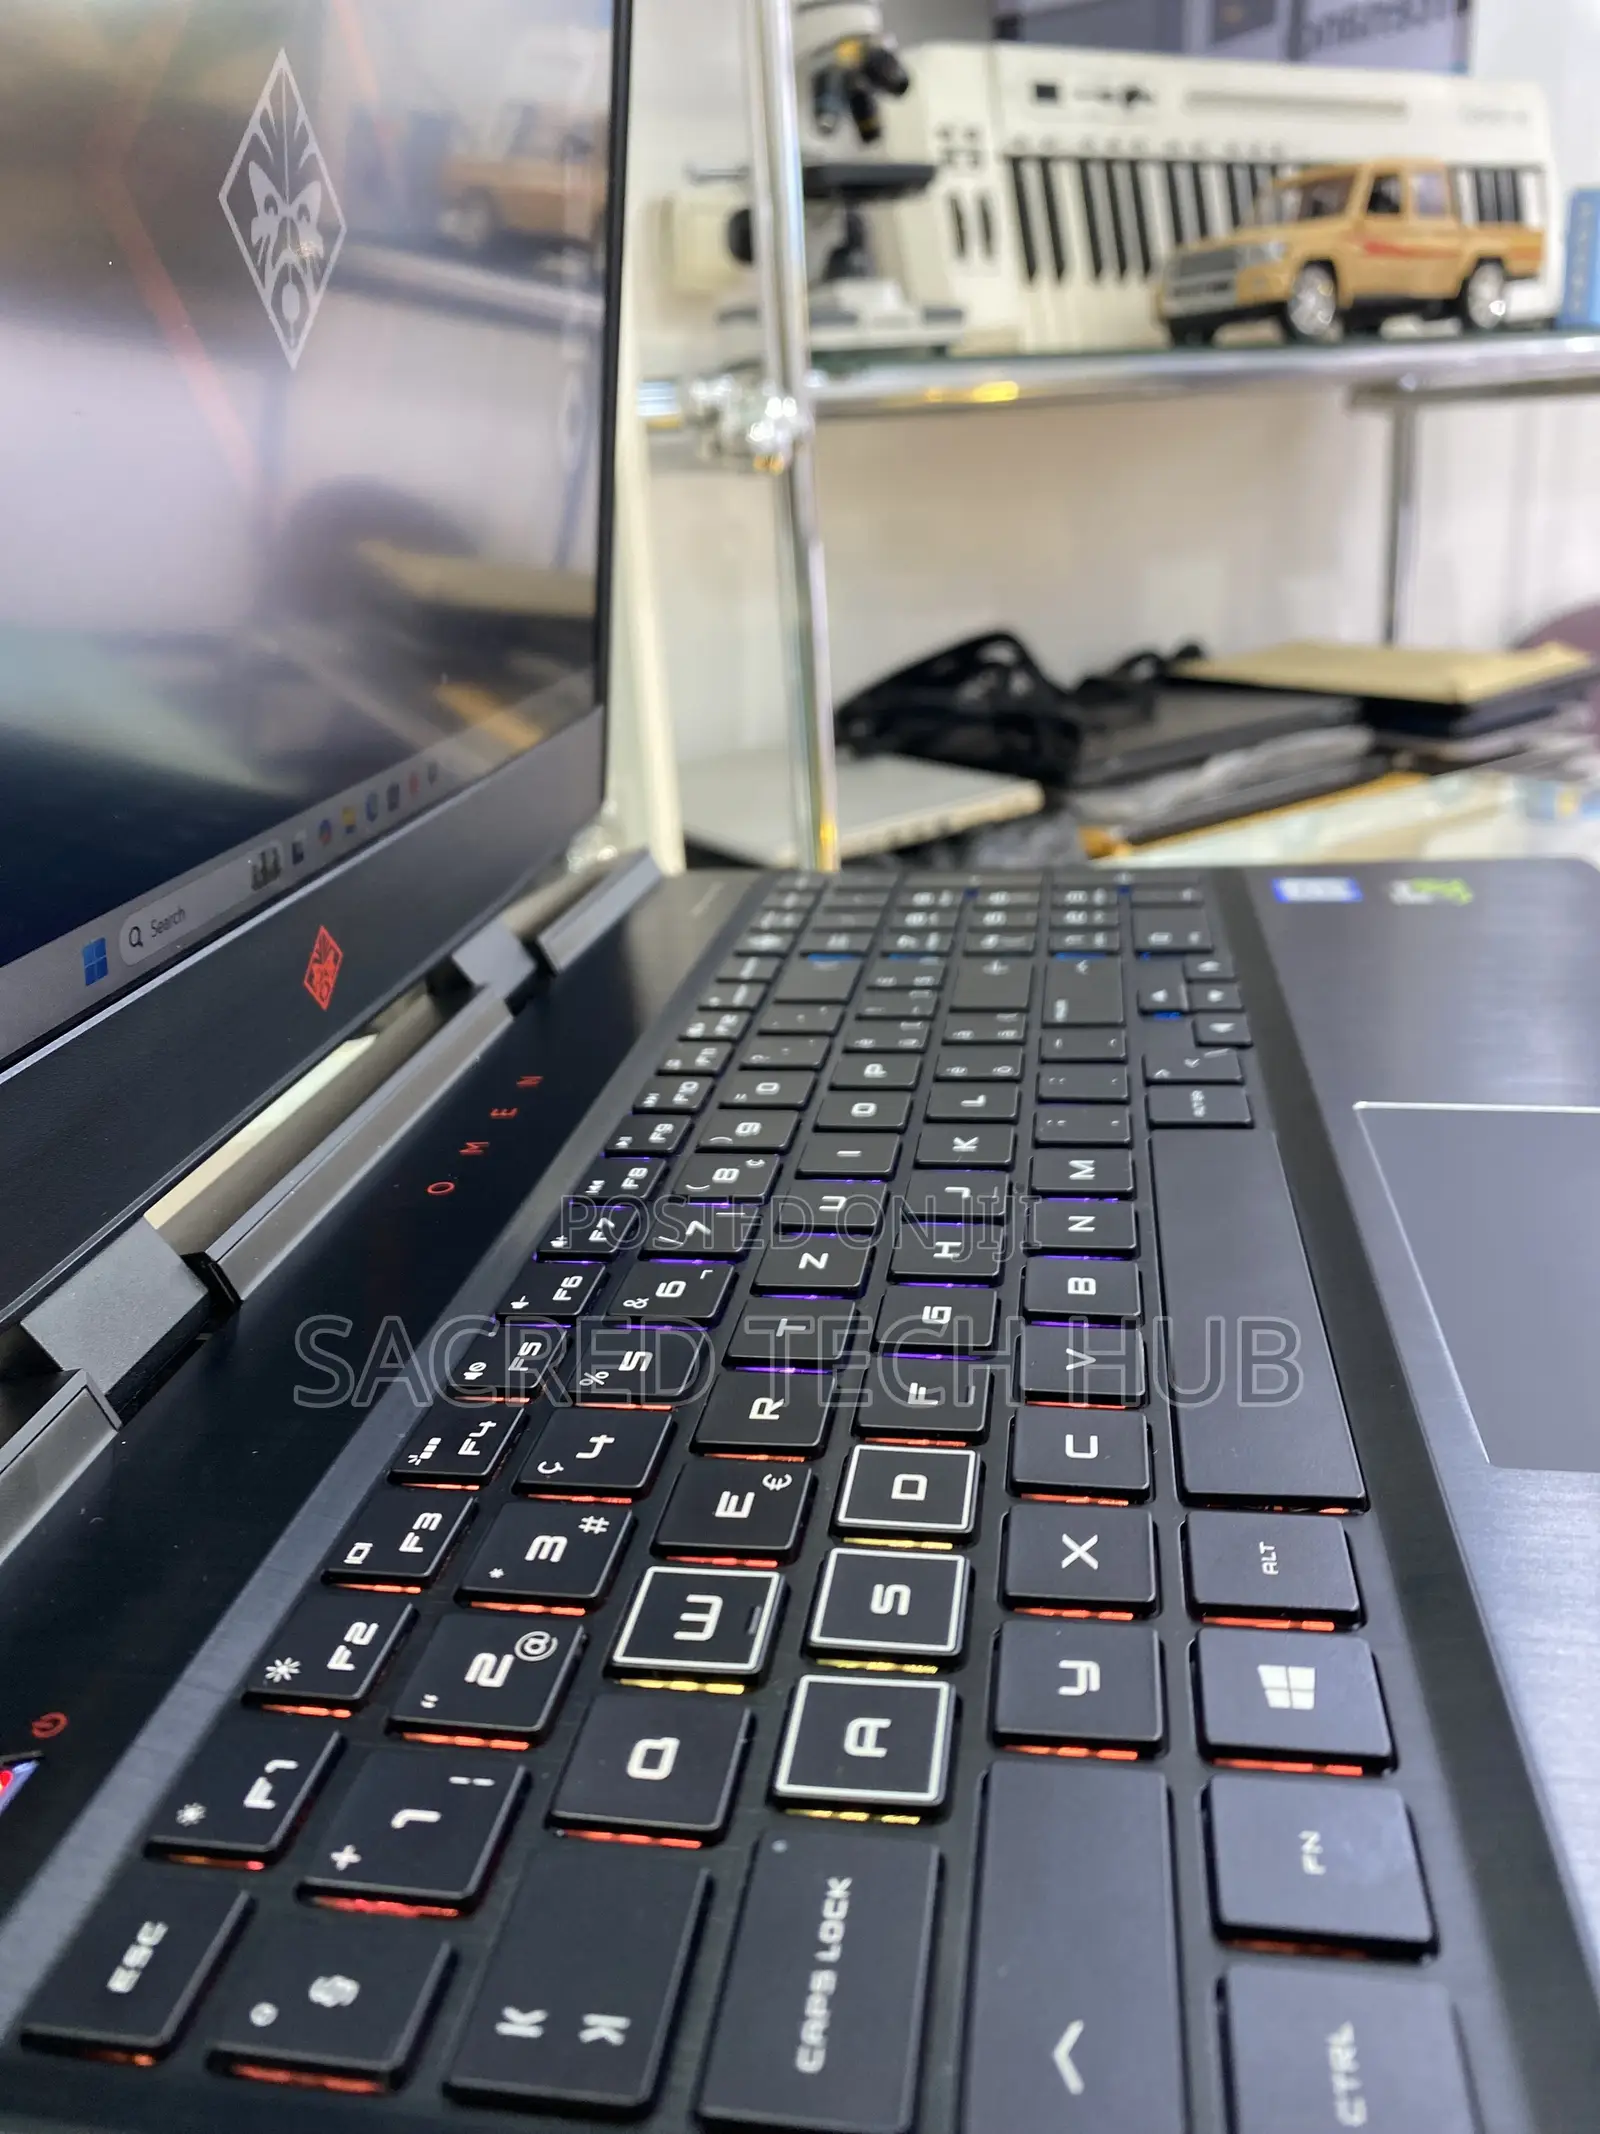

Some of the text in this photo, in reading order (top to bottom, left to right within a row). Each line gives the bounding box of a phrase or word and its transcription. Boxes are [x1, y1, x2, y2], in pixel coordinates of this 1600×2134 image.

[150, 906, 186, 938] Search
[863, 1063, 886, 1078] P
[672, 1081, 699, 1105] F10
[755, 1082, 780, 1095] 0
[961, 1094, 986, 1107] L
[648, 1123, 674, 1143] F9
[734, 1121, 762, 1137] 9
[952, 1136, 979, 1152] K
[621, 1167, 649, 1190] F8
[711, 1167, 740, 1184] 8
[1068, 1159, 1096, 1180] M
[819, 1195, 847, 1212] U
[944, 1186, 971, 1199] J
[588, 1217, 615, 1241] F7
[685, 1220, 711, 1236] 7
[1067, 1215, 1096, 1232] N
[798, 1252, 829, 1270] Z
[933, 1241, 963, 1260] H
[552, 1275, 583, 1301] F6
[655, 1280, 687, 1298] 6
[1067, 1276, 1097, 1296] B
[921, 1305, 953, 1325] G
[775, 1318, 806, 1337] T
[508, 1341, 543, 1372] F5
[618, 1351, 654, 1372] 5
[1065, 1348, 1097, 1371] V
[907, 1382, 938, 1406] F
[748, 1397, 785, 1420] R
[457, 1420, 497, 1457] F4
[575, 1434, 615, 1459] 4
[1065, 1433, 1099, 1459] C
[890, 1473, 928, 1501] D
[714, 1490, 756, 1519] E
[398, 1511, 443, 1554] F3
[524, 1535, 568, 1563] 3
[1061, 1533, 1099, 1570] X
[1258, 1541, 1279, 1575] ALT
[870, 1583, 912, 1616] S
[673, 1594, 724, 1642] W
[326, 1621, 379, 1672] F2
[464, 1652, 515, 1688] 2
[843, 1717, 892, 1758] A
[626, 1736, 680, 1781] Q
[243, 1758, 299, 1810] F1
[390, 1808, 441, 1829] 1
[1300, 1830, 1325, 1875] FN
[107, 1921, 168, 1993] ESC
[795, 1877, 852, 2074] CAPS LOCK
